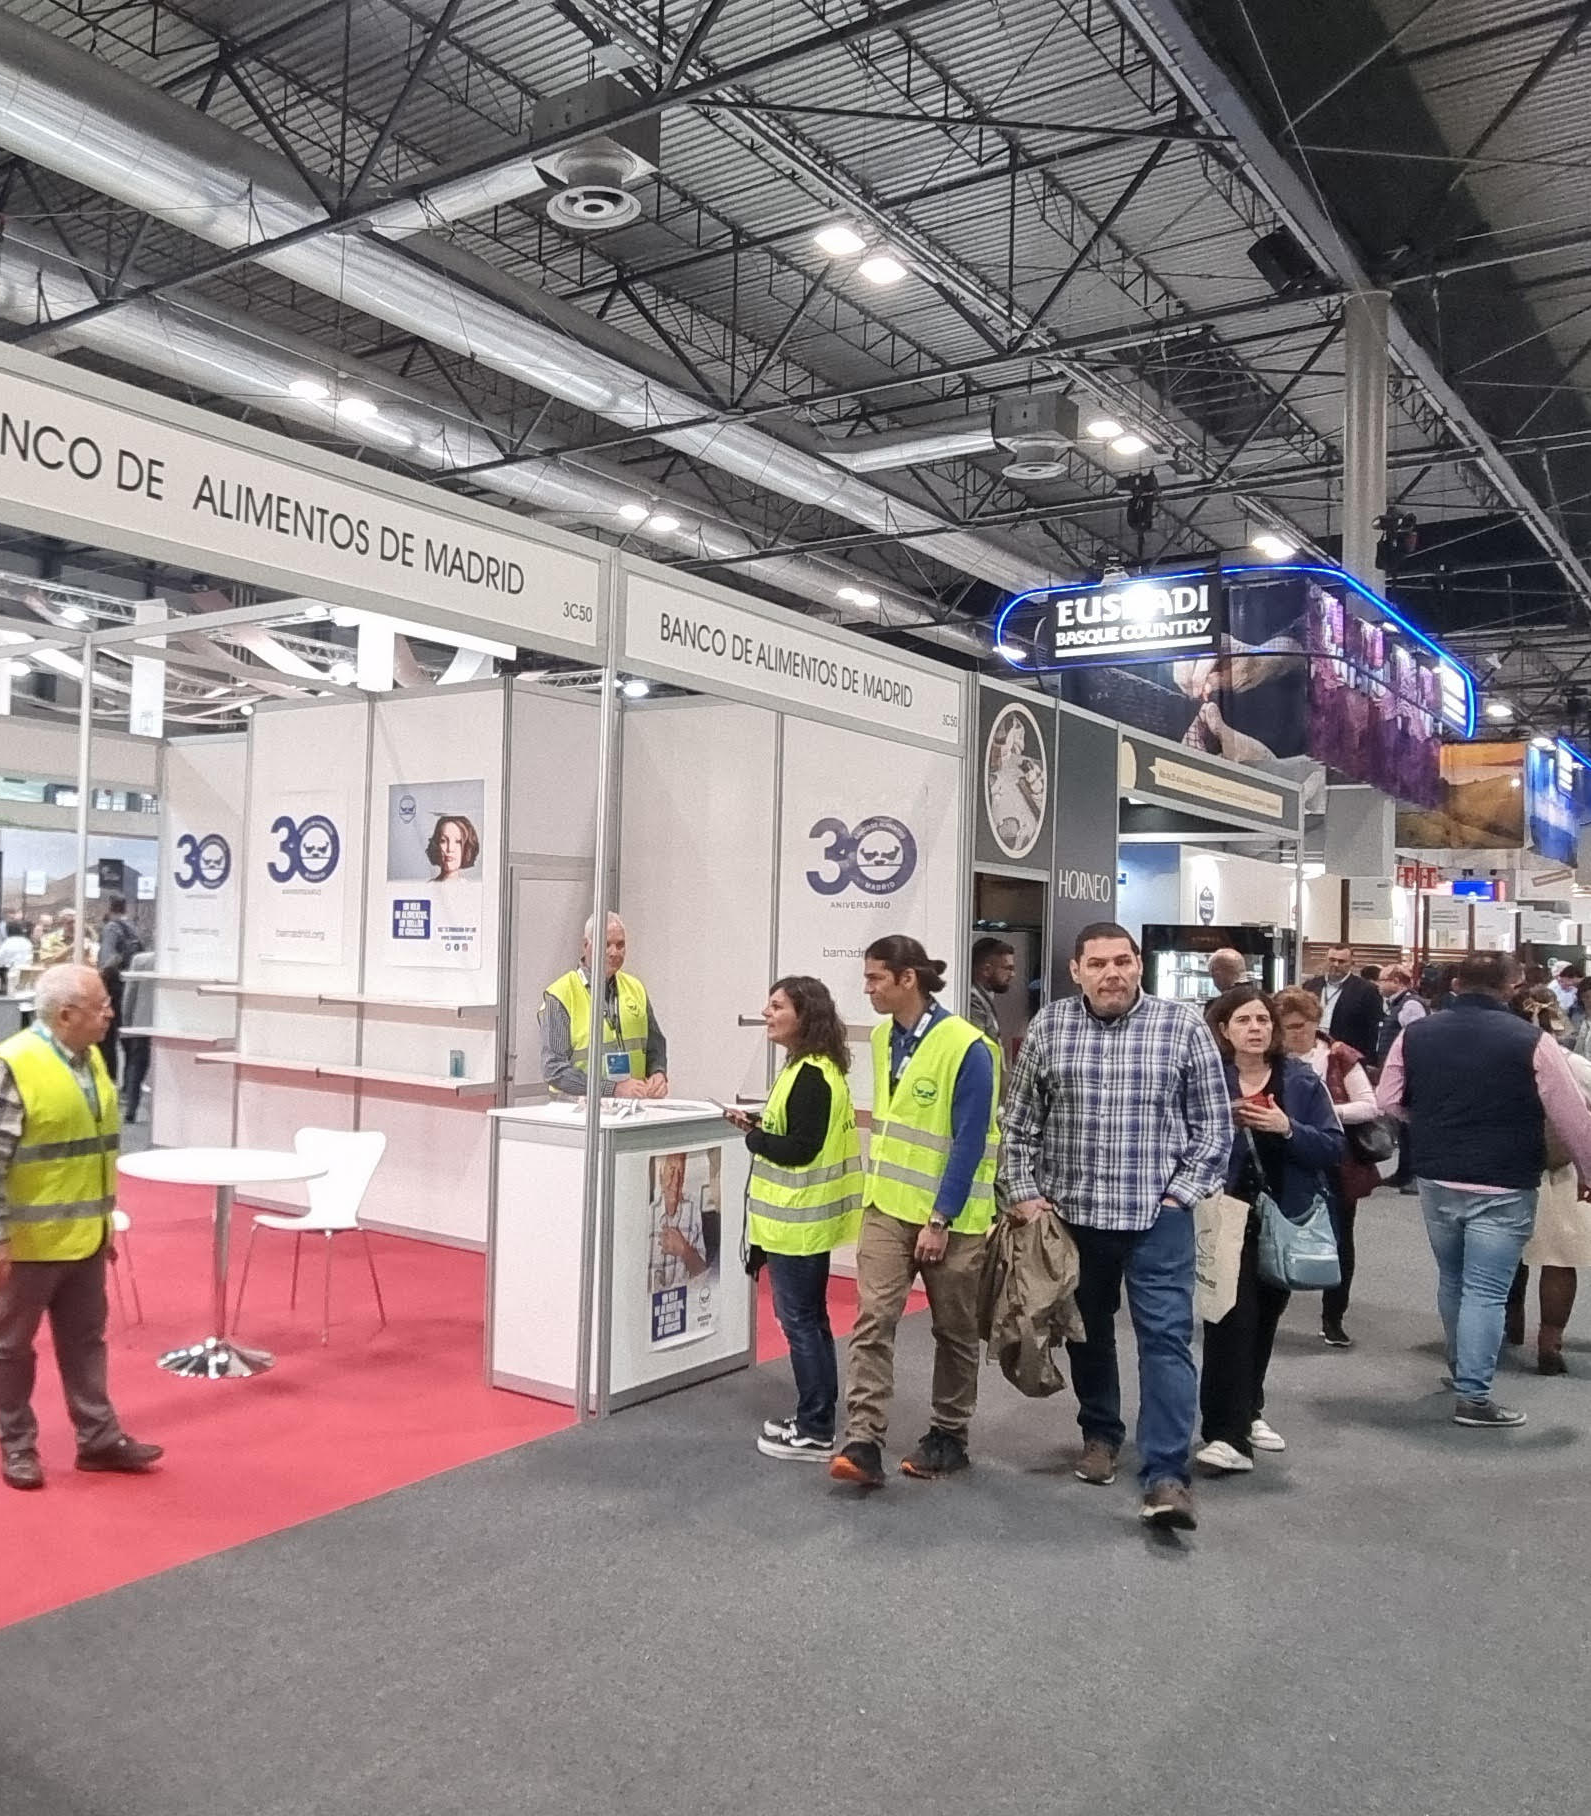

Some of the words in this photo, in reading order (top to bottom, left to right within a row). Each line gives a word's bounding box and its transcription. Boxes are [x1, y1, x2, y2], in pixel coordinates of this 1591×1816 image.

[116, 449, 164, 500] DE
[192, 474, 370, 556] ALIMENTOS
[379, 526, 415, 567] DE
[425, 538, 525, 595] MADRID
[562, 601, 593, 623] 3C50
[1056, 584, 1209, 627] EUSADI
[1055, 626, 1120, 647] BASQUE
[1121, 617, 1211, 641] COUNTRY
[660, 612, 726, 657] BANCO
[732, 634, 753, 665] DE
[756, 642, 838, 688] ALIMENTOS
[841, 666, 859, 694] DE
[863, 672, 913, 708] MADRID
[267, 815, 340, 883] 30
[806, 815, 917, 895] 30
[865, 881, 895, 891] MADRID
[1059, 869, 1111, 903] HORNEO
[830, 901, 891, 910] ANIVERSARIO
